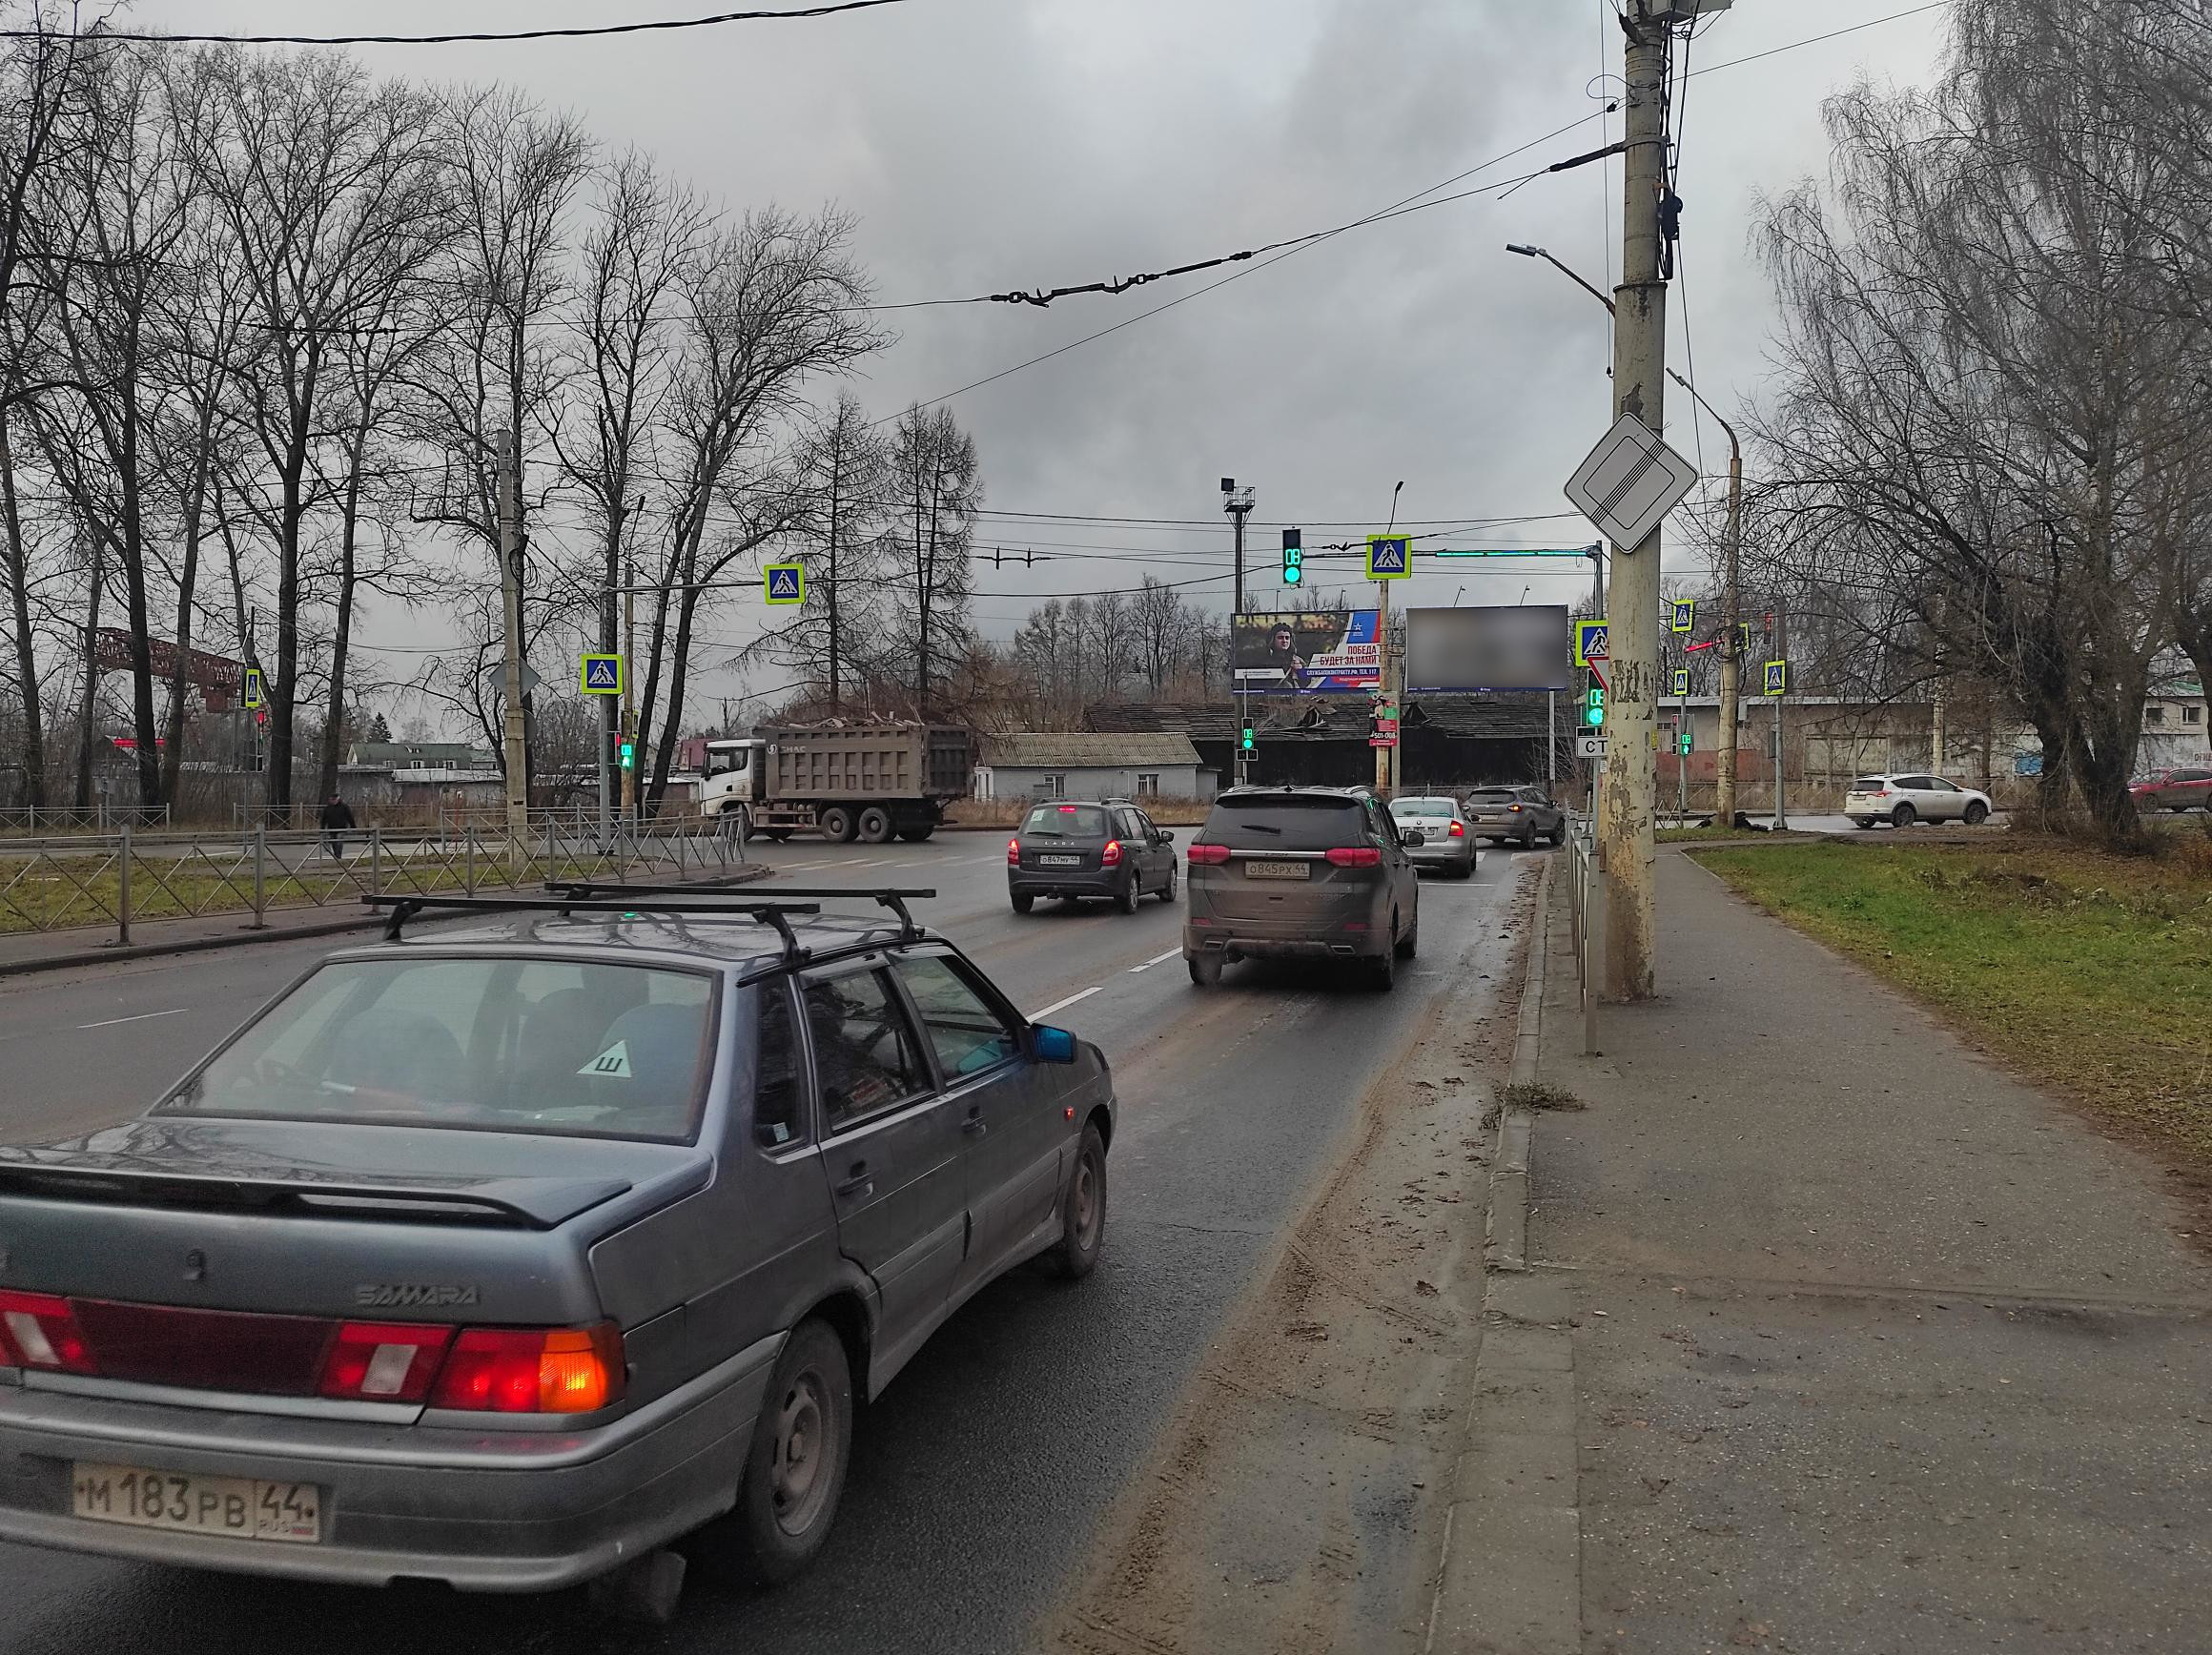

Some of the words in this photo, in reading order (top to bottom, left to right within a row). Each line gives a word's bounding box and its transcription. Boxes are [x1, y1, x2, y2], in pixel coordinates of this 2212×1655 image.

[1285, 549, 1301, 564] 08
[1347, 645, 1377, 655] ПОБЕДА
[1320, 656, 1342, 666] БУДЕТ
[1344, 656, 1354, 665] ЗА
[1355, 655, 1377, 665] НАМИ
[1586, 741, 1608, 753] СТ
[594, 1056, 624, 1073] Ш
[357, 1285, 481, 1307] SAMARA
